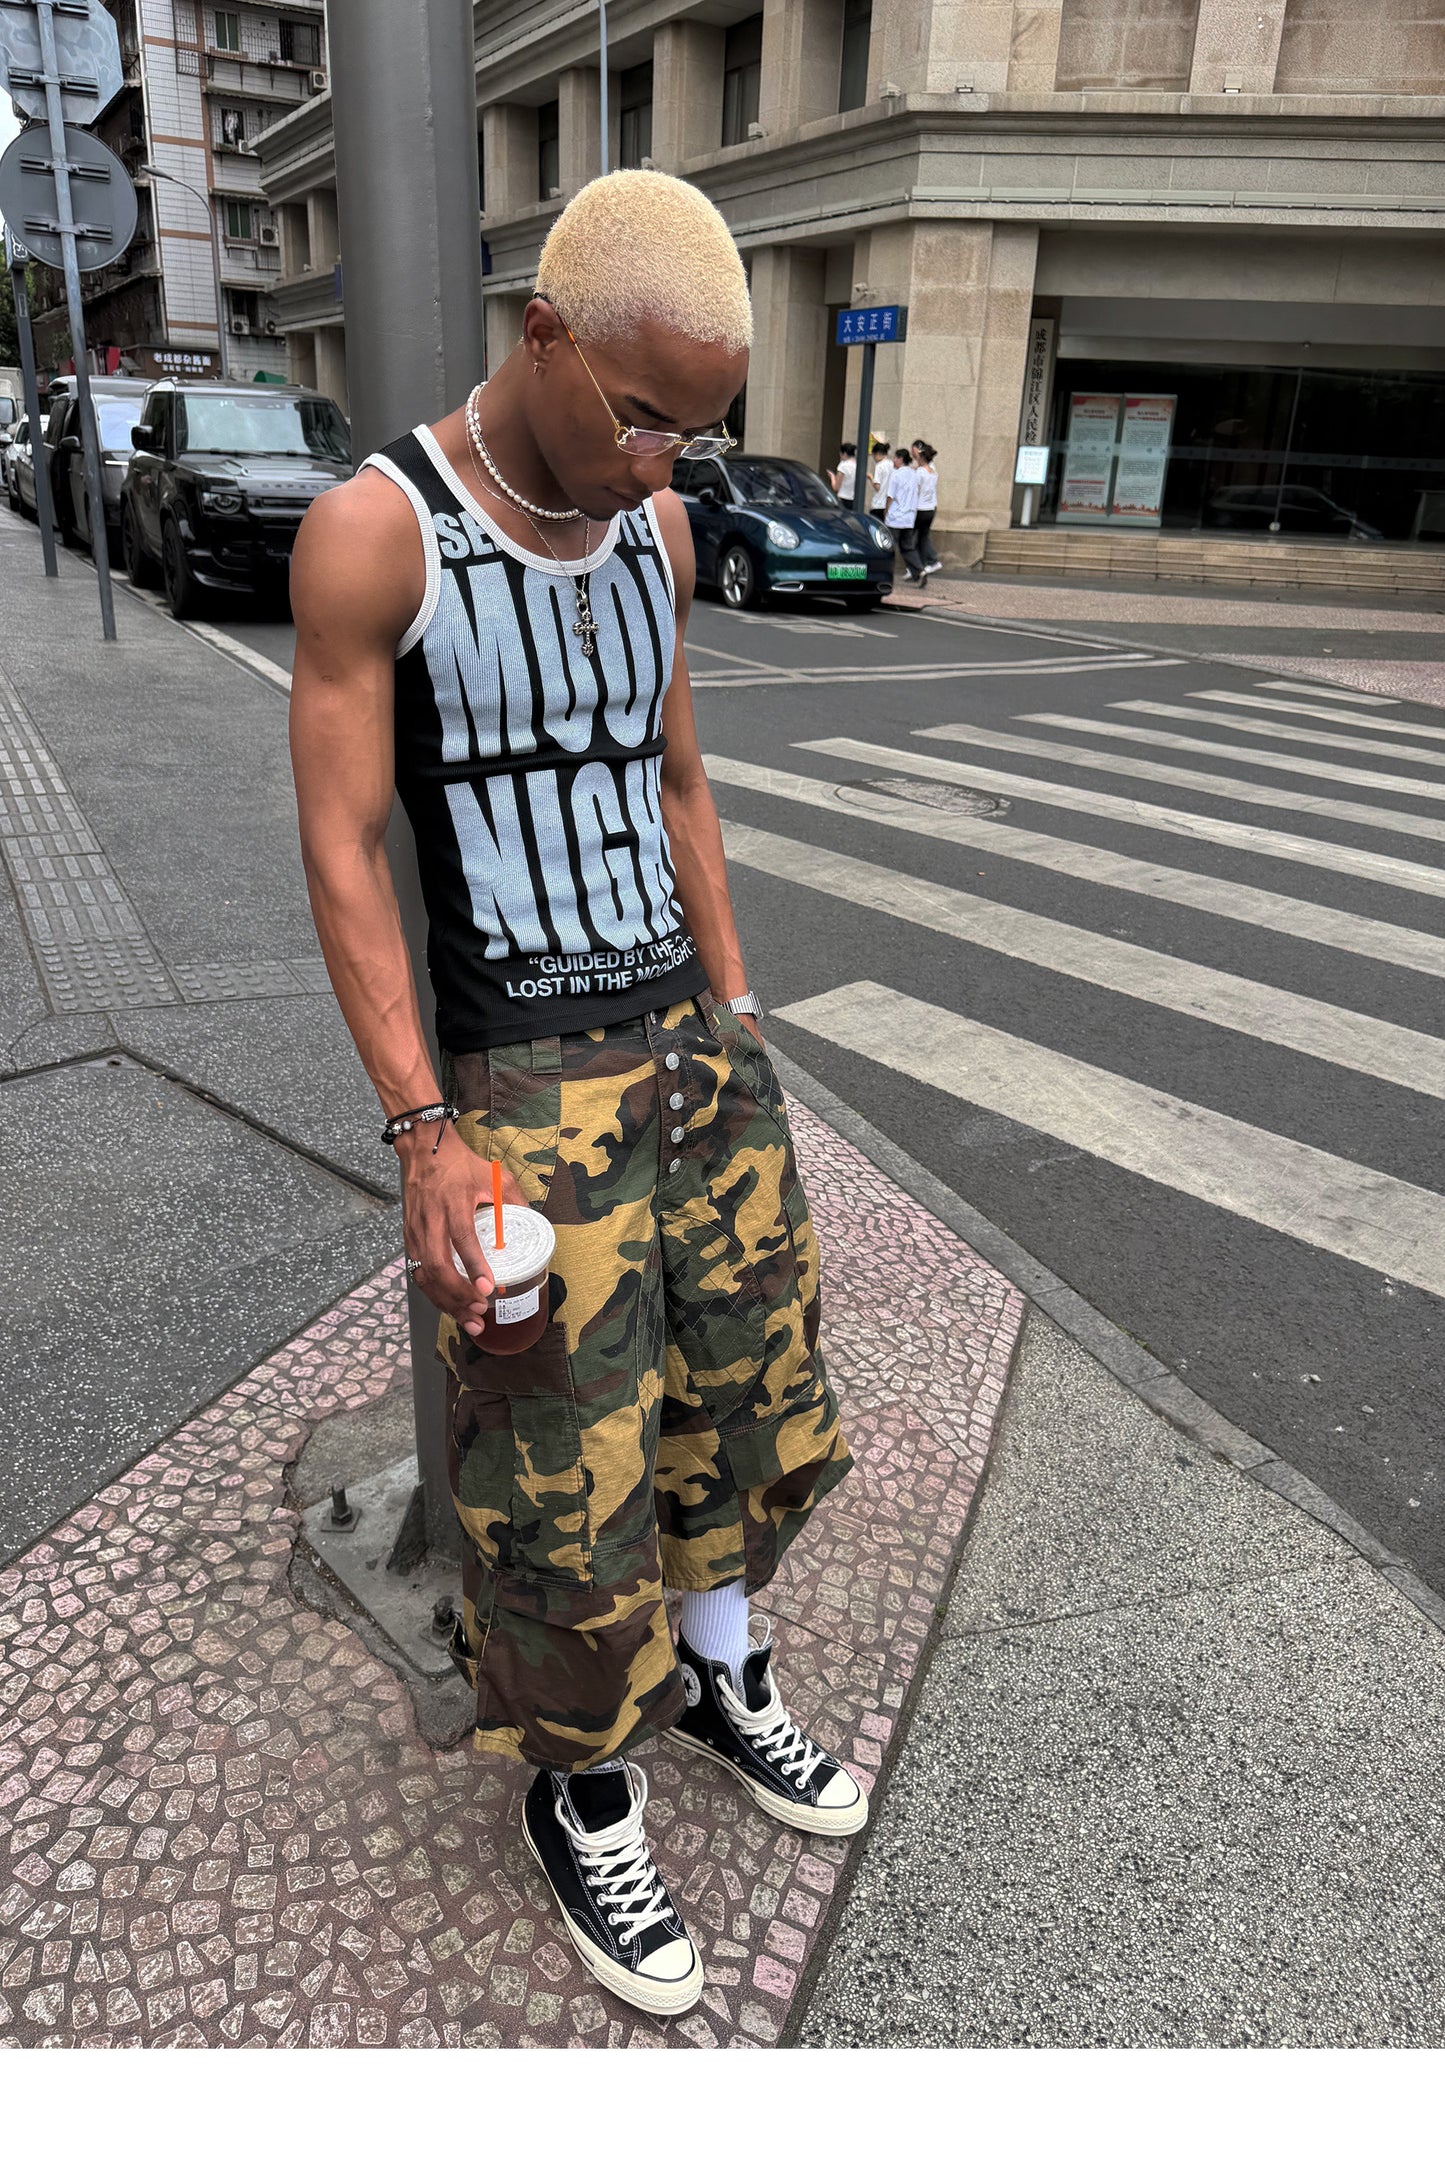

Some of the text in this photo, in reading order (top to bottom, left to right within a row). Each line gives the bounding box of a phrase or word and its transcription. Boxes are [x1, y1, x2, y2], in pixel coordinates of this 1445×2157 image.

[843, 312, 892, 333] 大安正街
[1025, 328, 1047, 446] 成都市锦江区人民检
[529, 951, 620, 974] “GUIDED
[624, 946, 646, 967] BY
[506, 977, 565, 998] LOST
[570, 975, 591, 995] IN
[594, 970, 633, 992] THE
